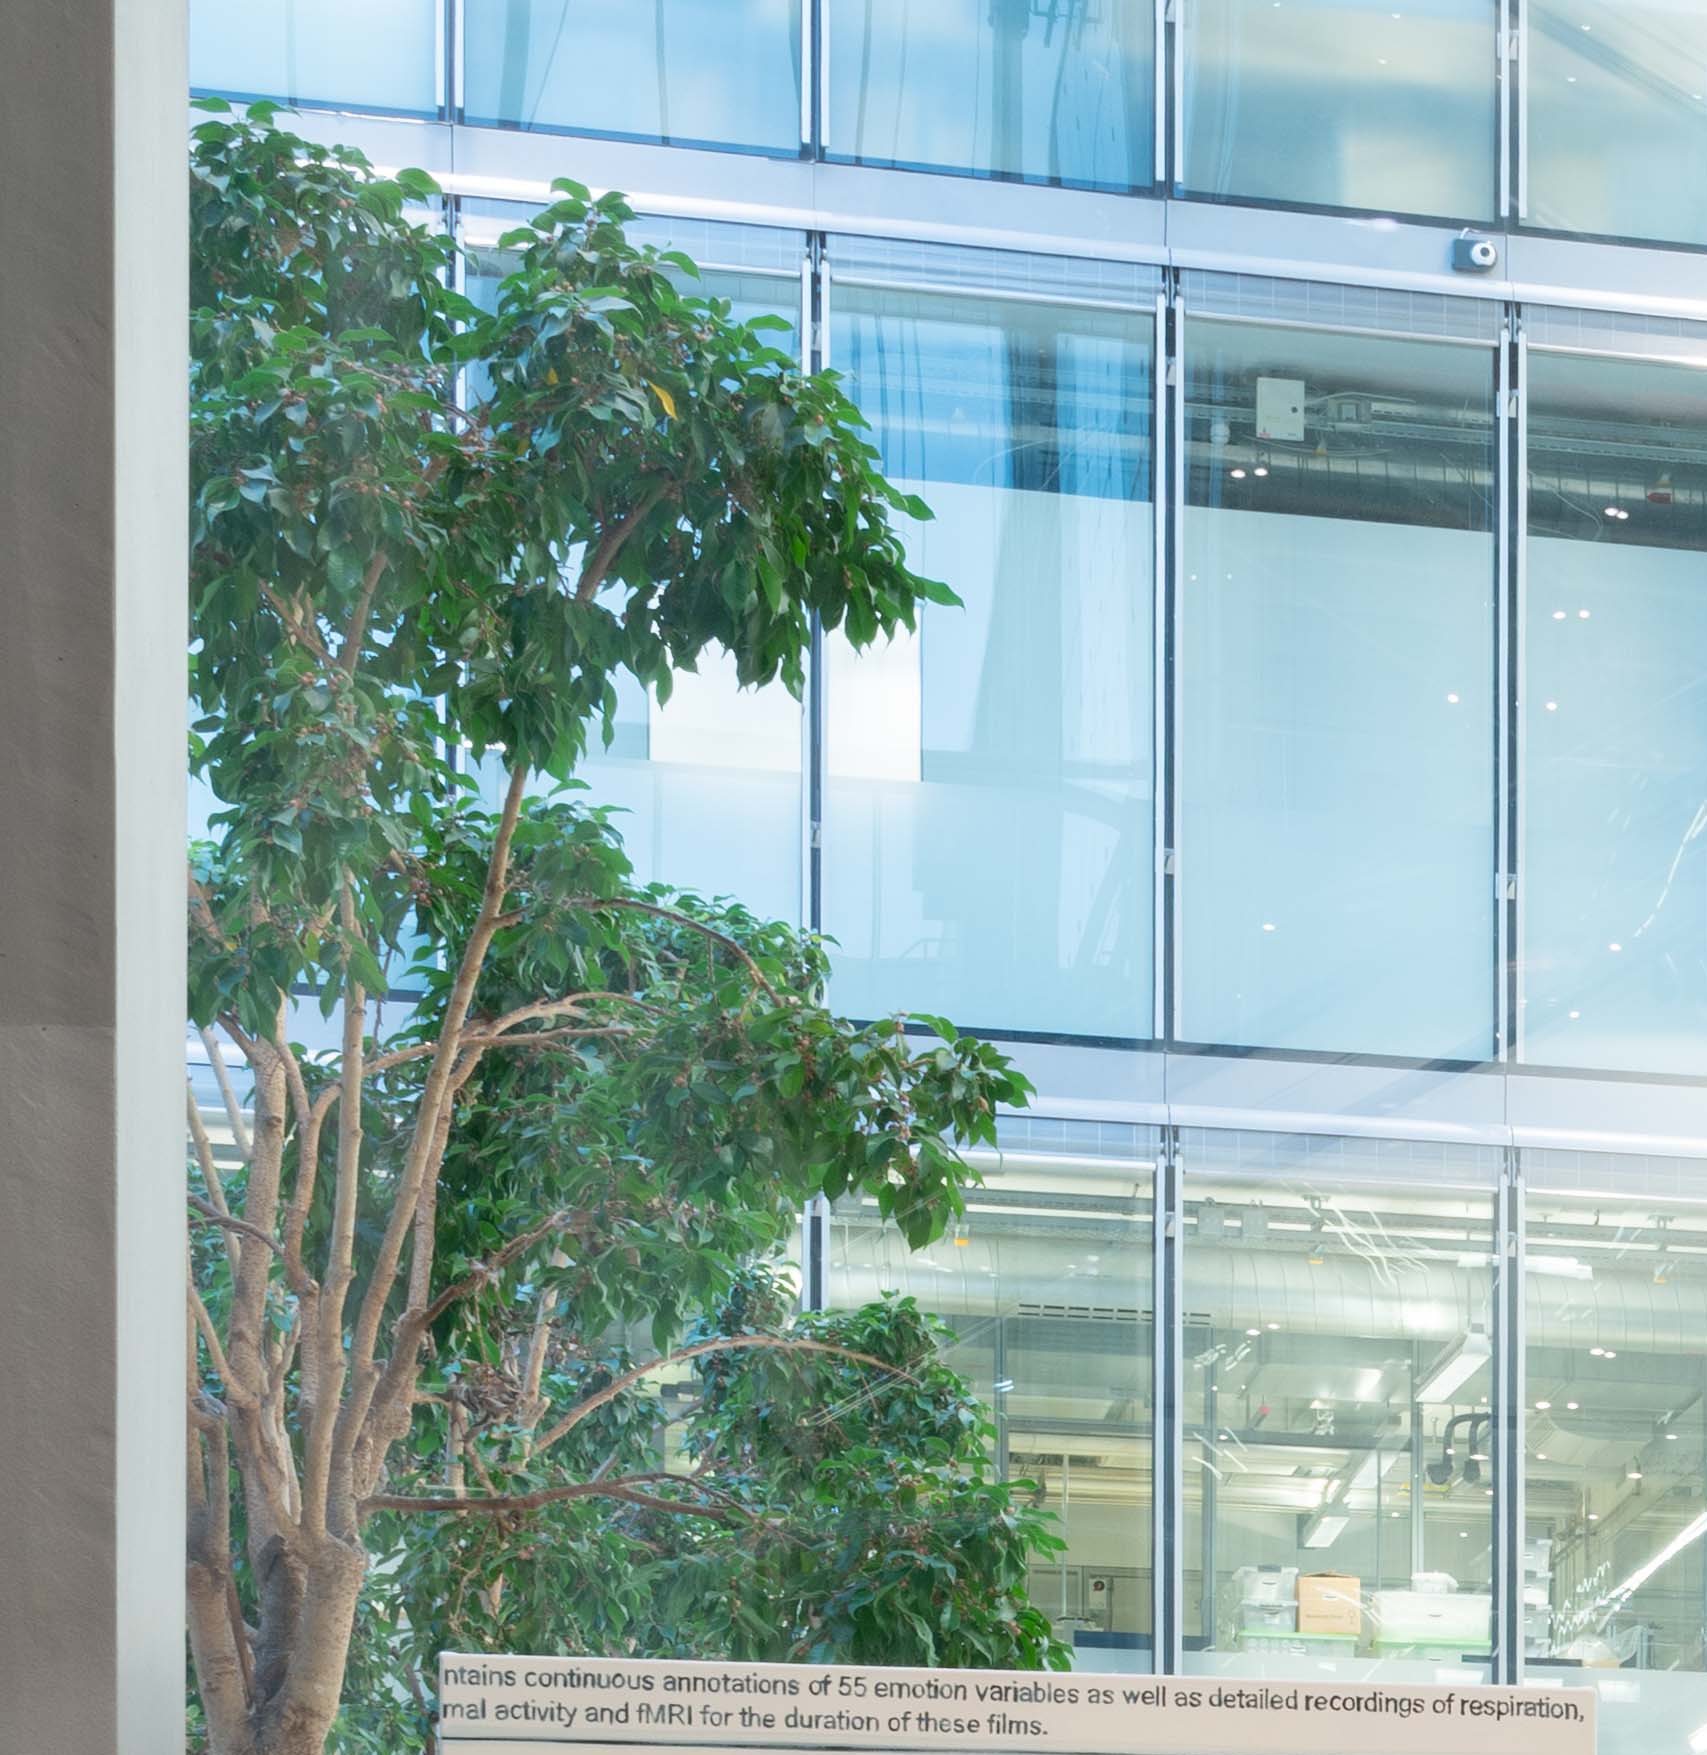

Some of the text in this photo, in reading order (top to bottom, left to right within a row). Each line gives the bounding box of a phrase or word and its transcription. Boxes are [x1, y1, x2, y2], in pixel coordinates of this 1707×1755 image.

[524, 1667, 1585, 1723] continuous annotations of 55 emotion variables as well as detailed recordings of respiration,
[494, 1701, 1048, 1736] activity and fMRI for the duration of these films.
